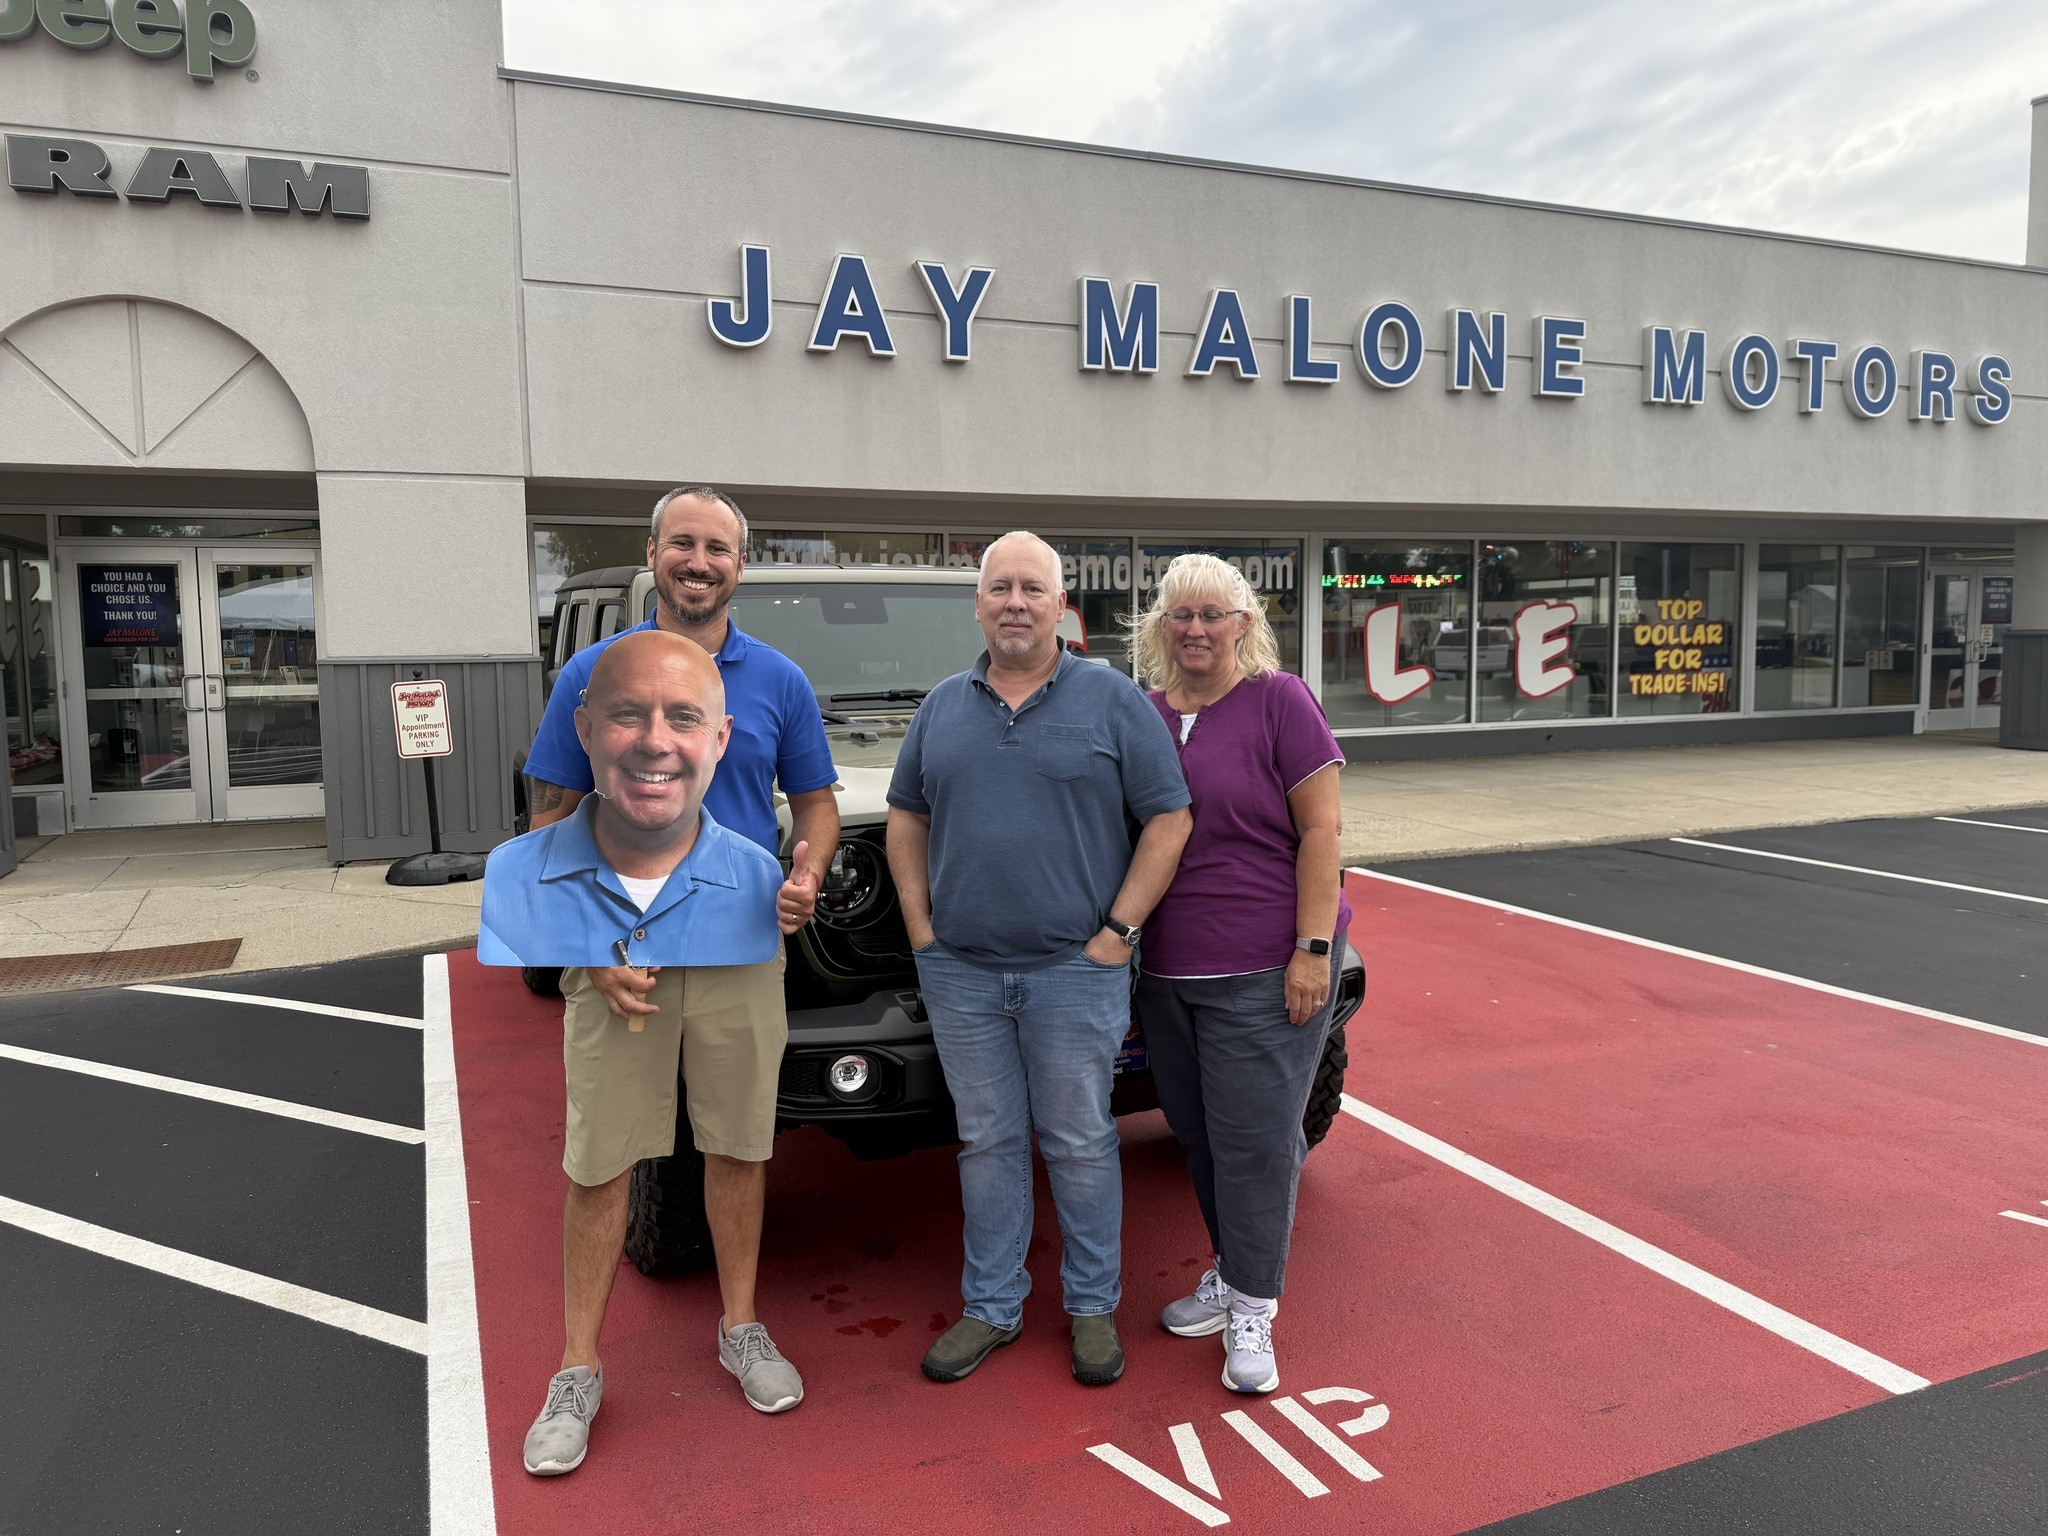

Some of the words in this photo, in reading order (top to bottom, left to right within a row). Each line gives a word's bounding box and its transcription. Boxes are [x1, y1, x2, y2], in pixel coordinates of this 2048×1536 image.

[4, 134, 370, 220] RAM
[707, 243, 997, 362] JAY
[1077, 275, 1587, 398] MALONE
[1642, 325, 2012, 427] MOTORS
[103, 572, 122, 581] YOU
[124, 572, 144, 581] HAD
[146, 572, 153, 581] A
[90, 583, 125, 593] CHOICE
[127, 583, 146, 593] AND
[147, 583, 166, 593] YOU
[106, 595, 136, 605] CHOSE
[138, 595, 153, 605] US.
[1657, 599, 1703, 620] TOP
[103, 611, 134, 620] THANK
[135, 611, 158, 620] YOU!
[106, 628, 122, 637] JAY
[122, 628, 156, 637] MALONE
[1634, 623, 1724, 647] DOLLAR
[1654, 648, 1702, 671] FOR
[1629, 672, 1726, 695] TRADE-INS!
[415, 713, 429, 722] VIP
[401, 721, 445, 732] Appointment
[408, 730, 440, 740] PARKING
[415, 740, 435, 749] ONLY
[1085, 1386, 1391, 1528] VIP
